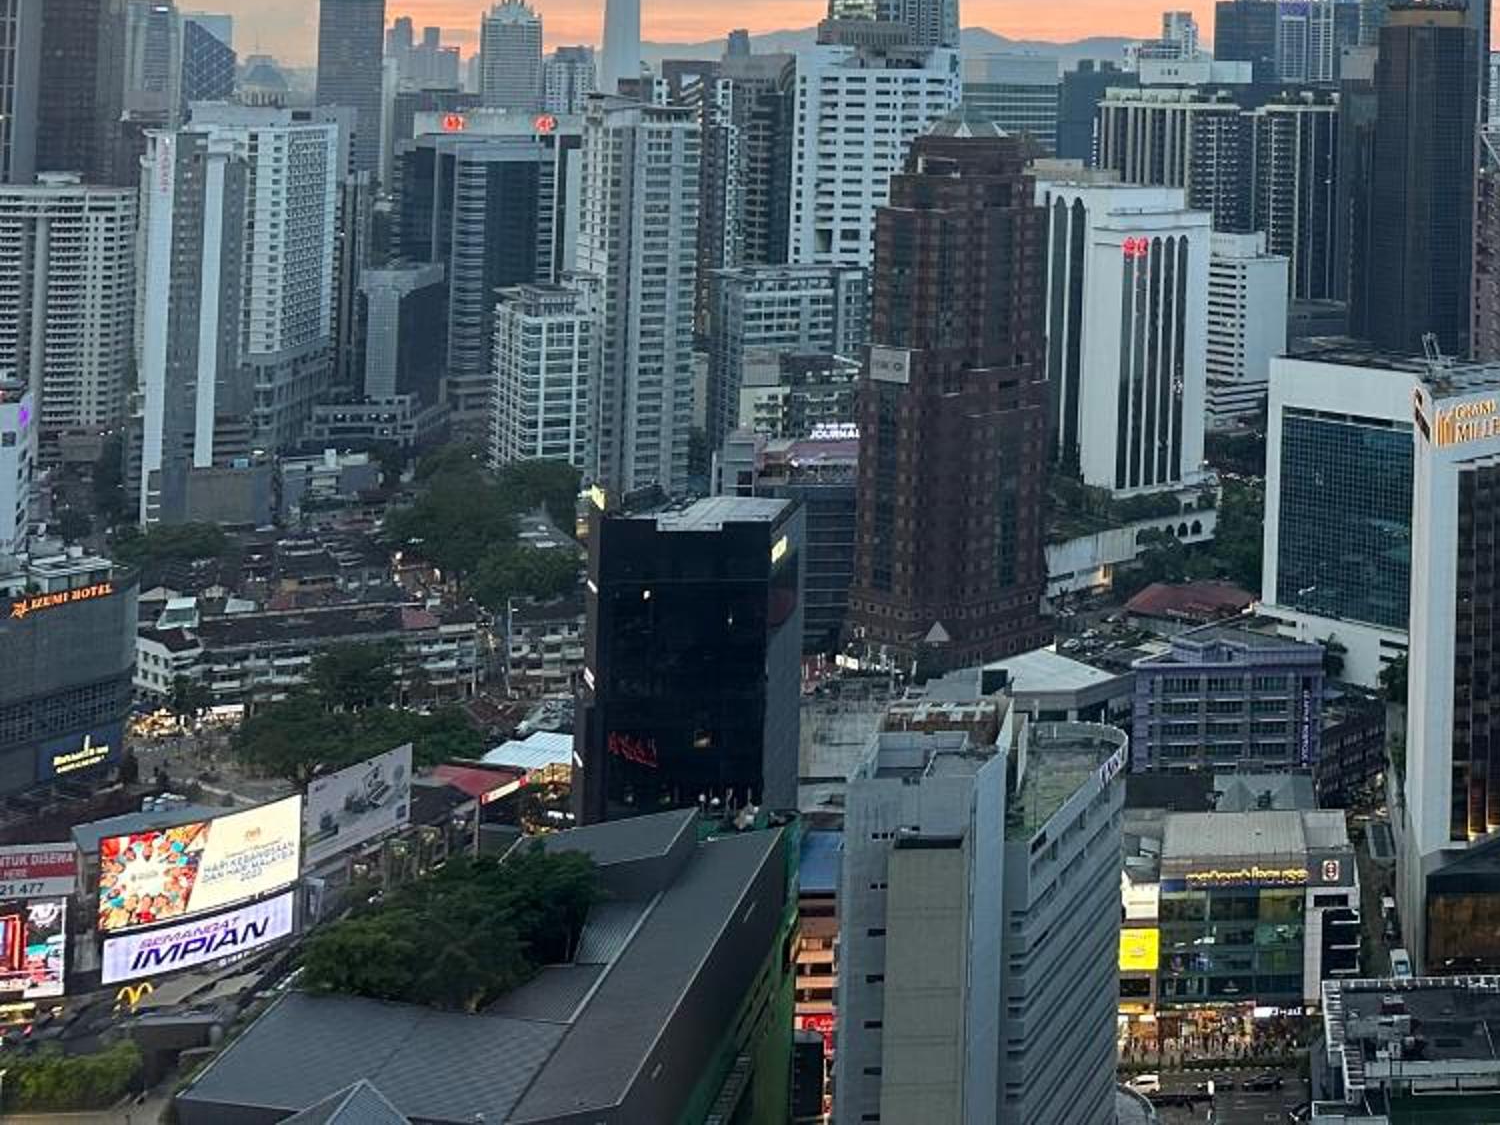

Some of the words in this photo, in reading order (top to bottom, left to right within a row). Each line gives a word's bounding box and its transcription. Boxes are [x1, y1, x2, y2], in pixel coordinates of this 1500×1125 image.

[810, 428, 860, 440] JOURNAL
[71, 582, 113, 601] HOTEL
[31, 852, 74, 866] DISEWA
[19, 882, 45, 894] 477
[130, 916, 270, 971] IMPIAN
